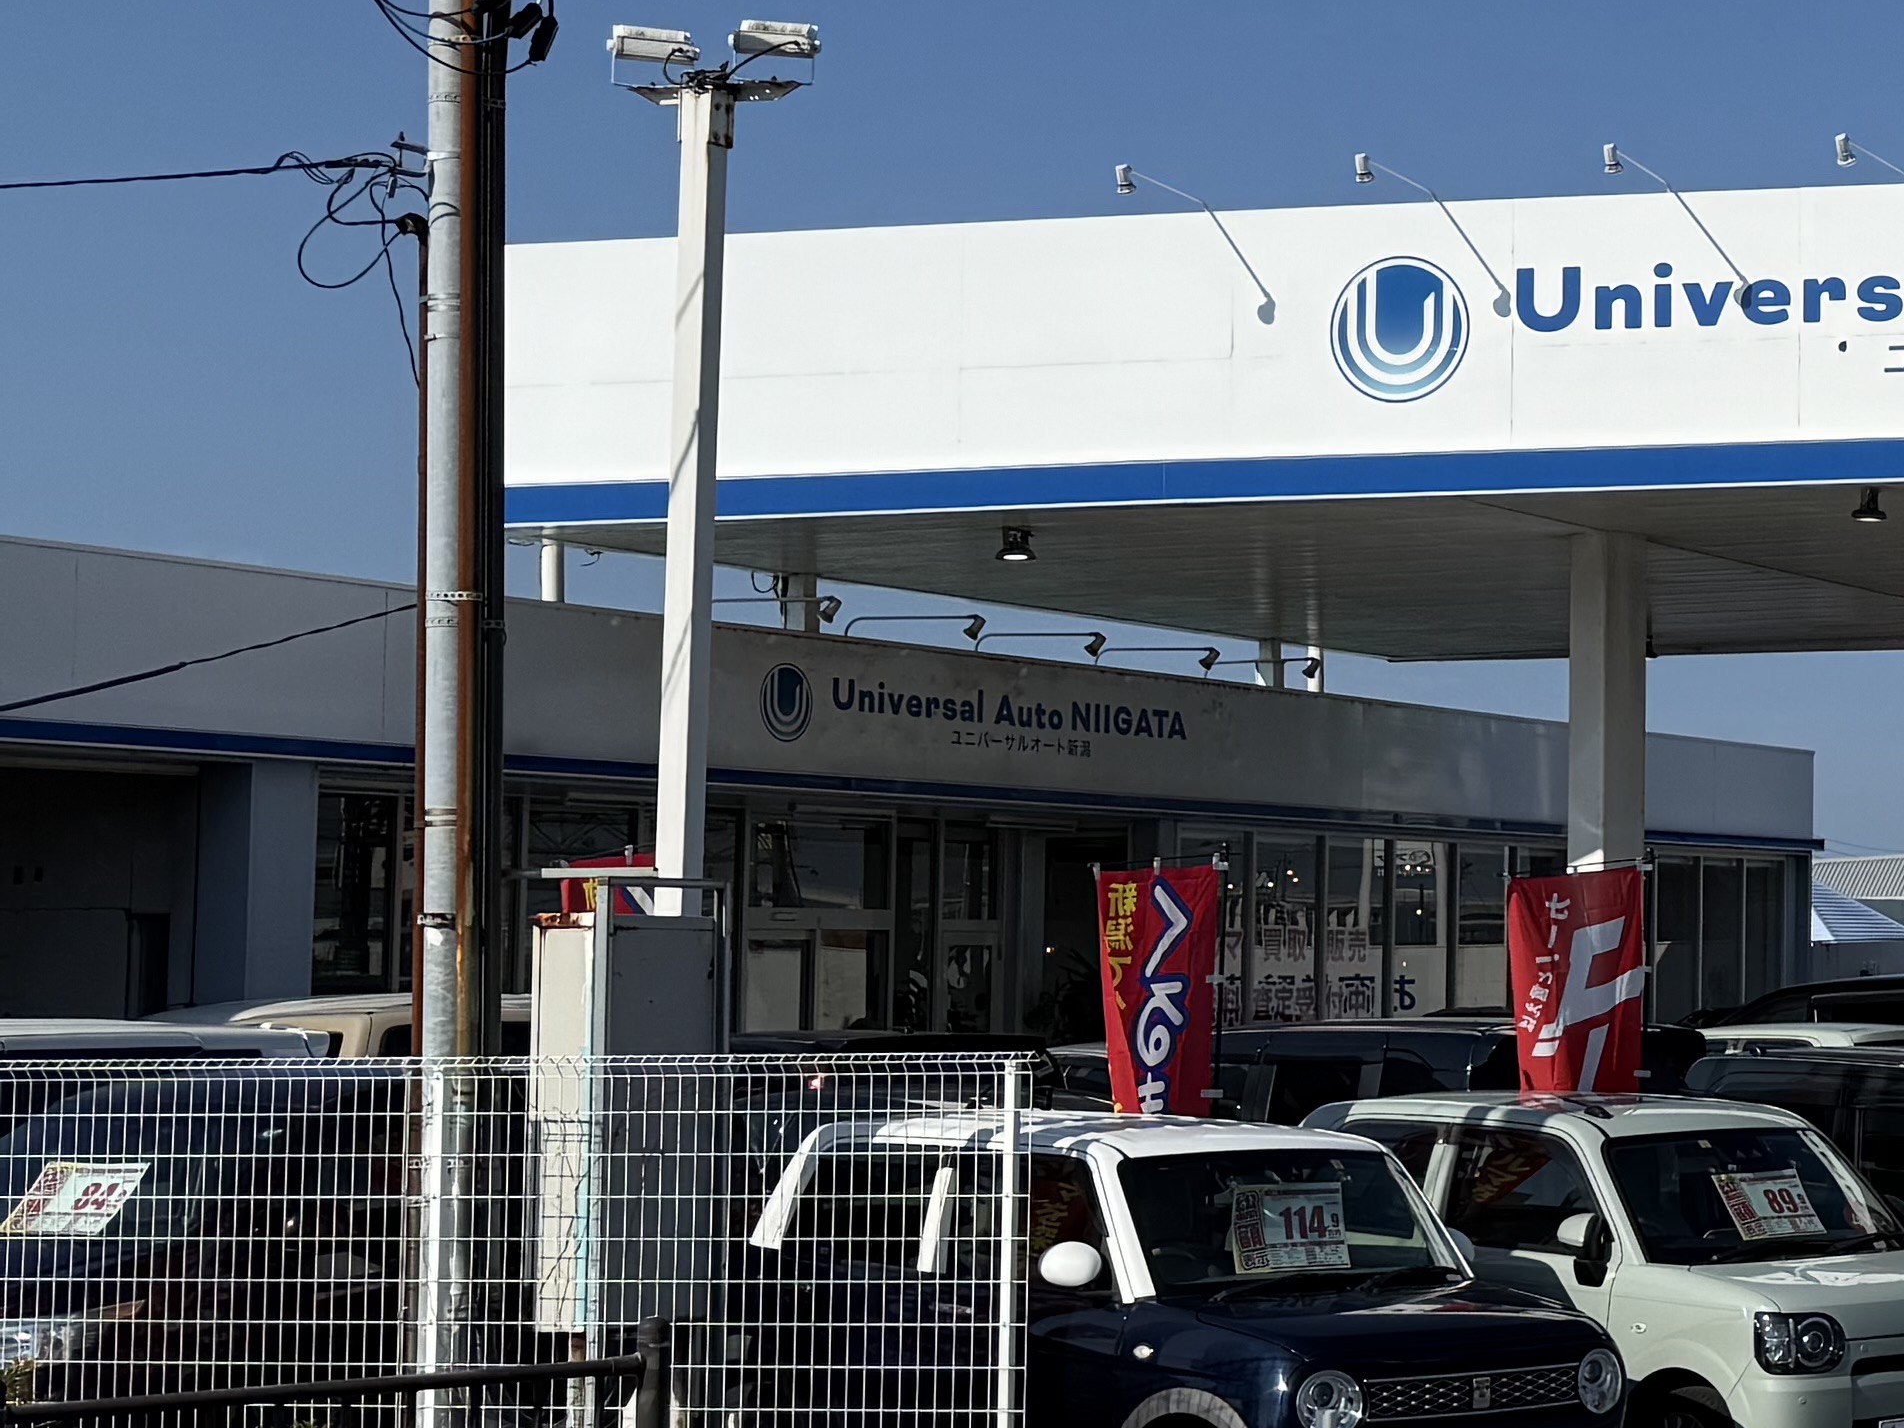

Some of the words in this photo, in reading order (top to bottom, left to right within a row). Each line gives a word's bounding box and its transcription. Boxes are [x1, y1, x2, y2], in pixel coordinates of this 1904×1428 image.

[832, 677, 983, 723] Universal
[994, 695, 1063, 730] Auto
[1072, 702, 1187, 740] NIIGATA
[951, 731, 1092, 758] ユニバーサルオート新潟
